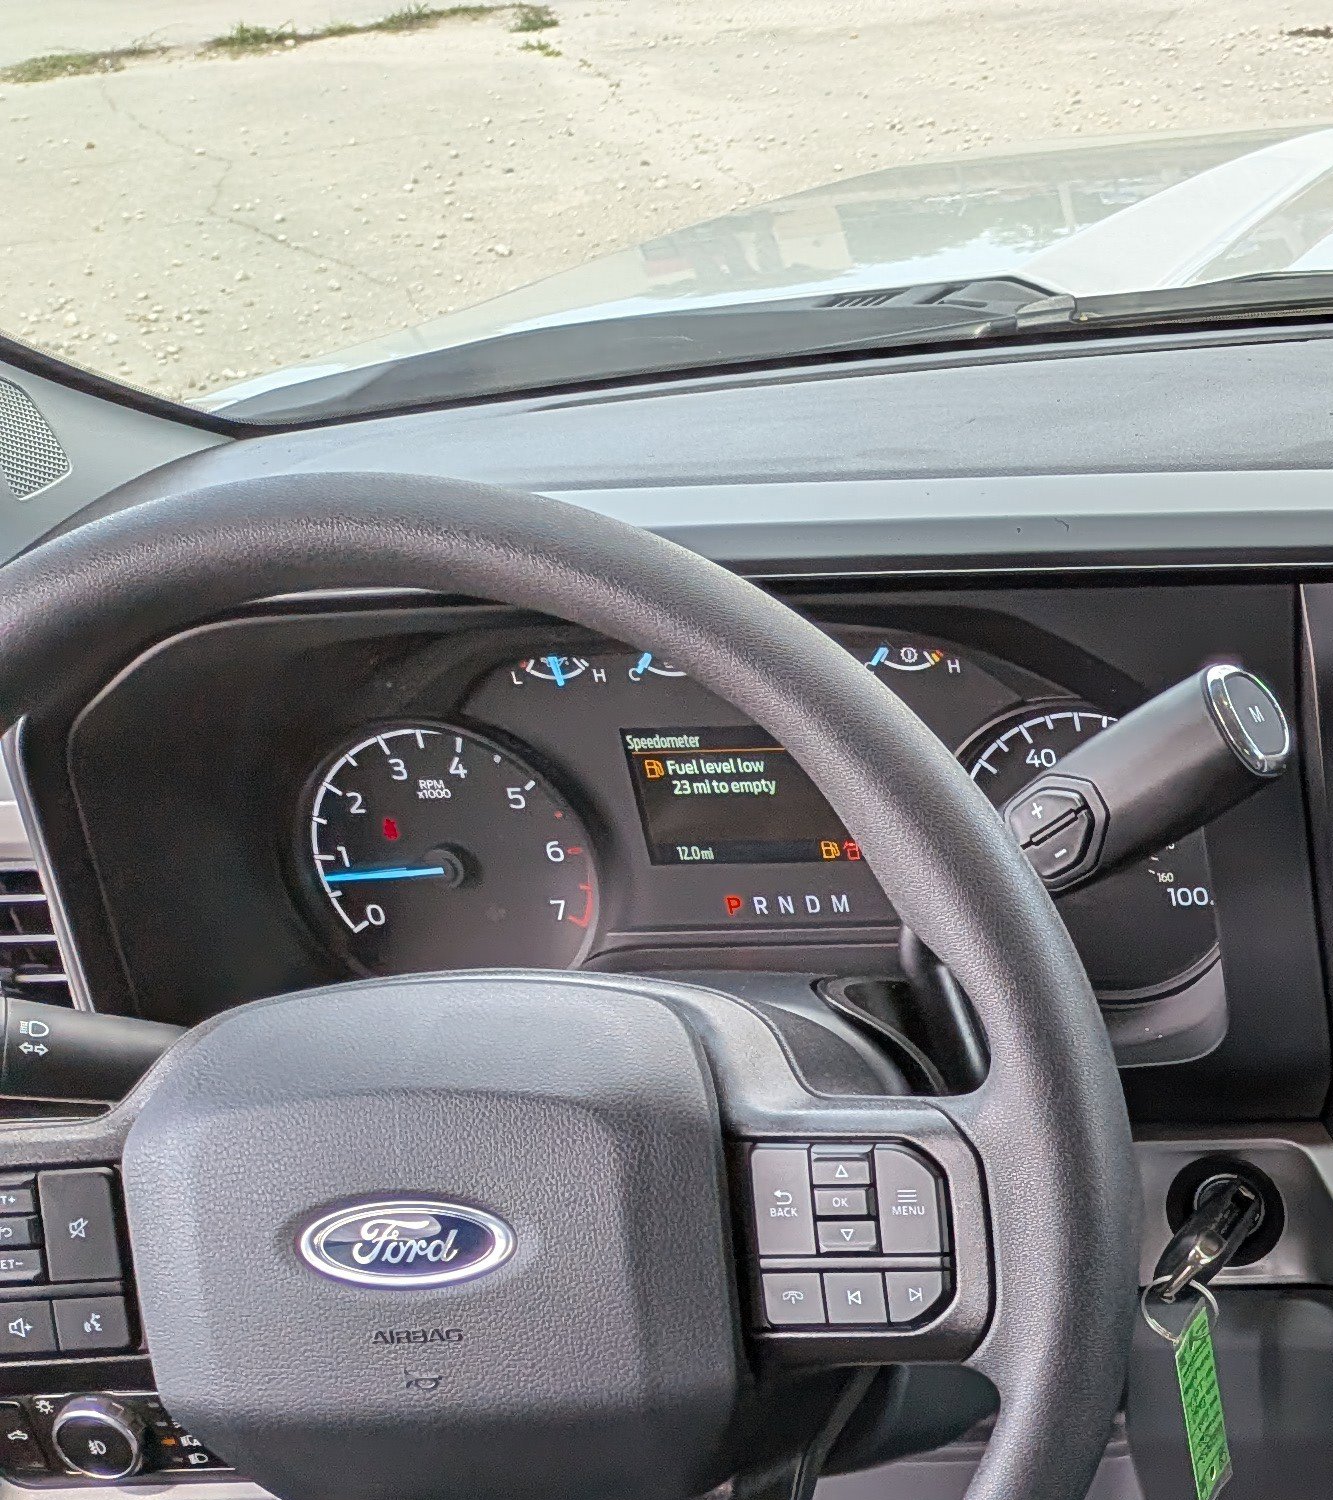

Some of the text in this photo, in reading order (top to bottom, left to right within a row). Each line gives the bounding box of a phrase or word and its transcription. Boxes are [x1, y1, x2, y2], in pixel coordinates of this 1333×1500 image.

[948, 658, 960, 674] H
[511, 670, 524, 685] L
[593, 668, 608, 683] H
[1247, 706, 1266, 723] M
[626, 734, 701, 751] Speedometer
[448, 756, 469, 779] 4
[666, 757, 765, 776] Fuel level low
[1025, 748, 1057, 769] 40
[390, 758, 409, 781] 3
[418, 779, 445, 790] RPM
[672, 779, 692, 796] 23
[712, 779, 729, 794] to
[731, 779, 777, 797] empty
[347, 791, 367, 815] 2
[507, 787, 526, 810] 5
[337, 845, 351, 867] 1
[546, 840, 565, 863] 6
[677, 846, 715, 861] 12.0 mi
[1156, 871, 1175, 883] 160
[725, 893, 851, 916] P R N D M
[1167, 887, 1208, 907] 100
[366, 904, 386, 926] 0
[550, 900, 566, 922] 7
[769, 1206, 799, 1218] BACK
[832, 1197, 849, 1209] OK
[891, 1205, 925, 1216] MENU
[352, 1218, 459, 1265] Ford
[371, 1328, 464, 1345] AIRBAG
